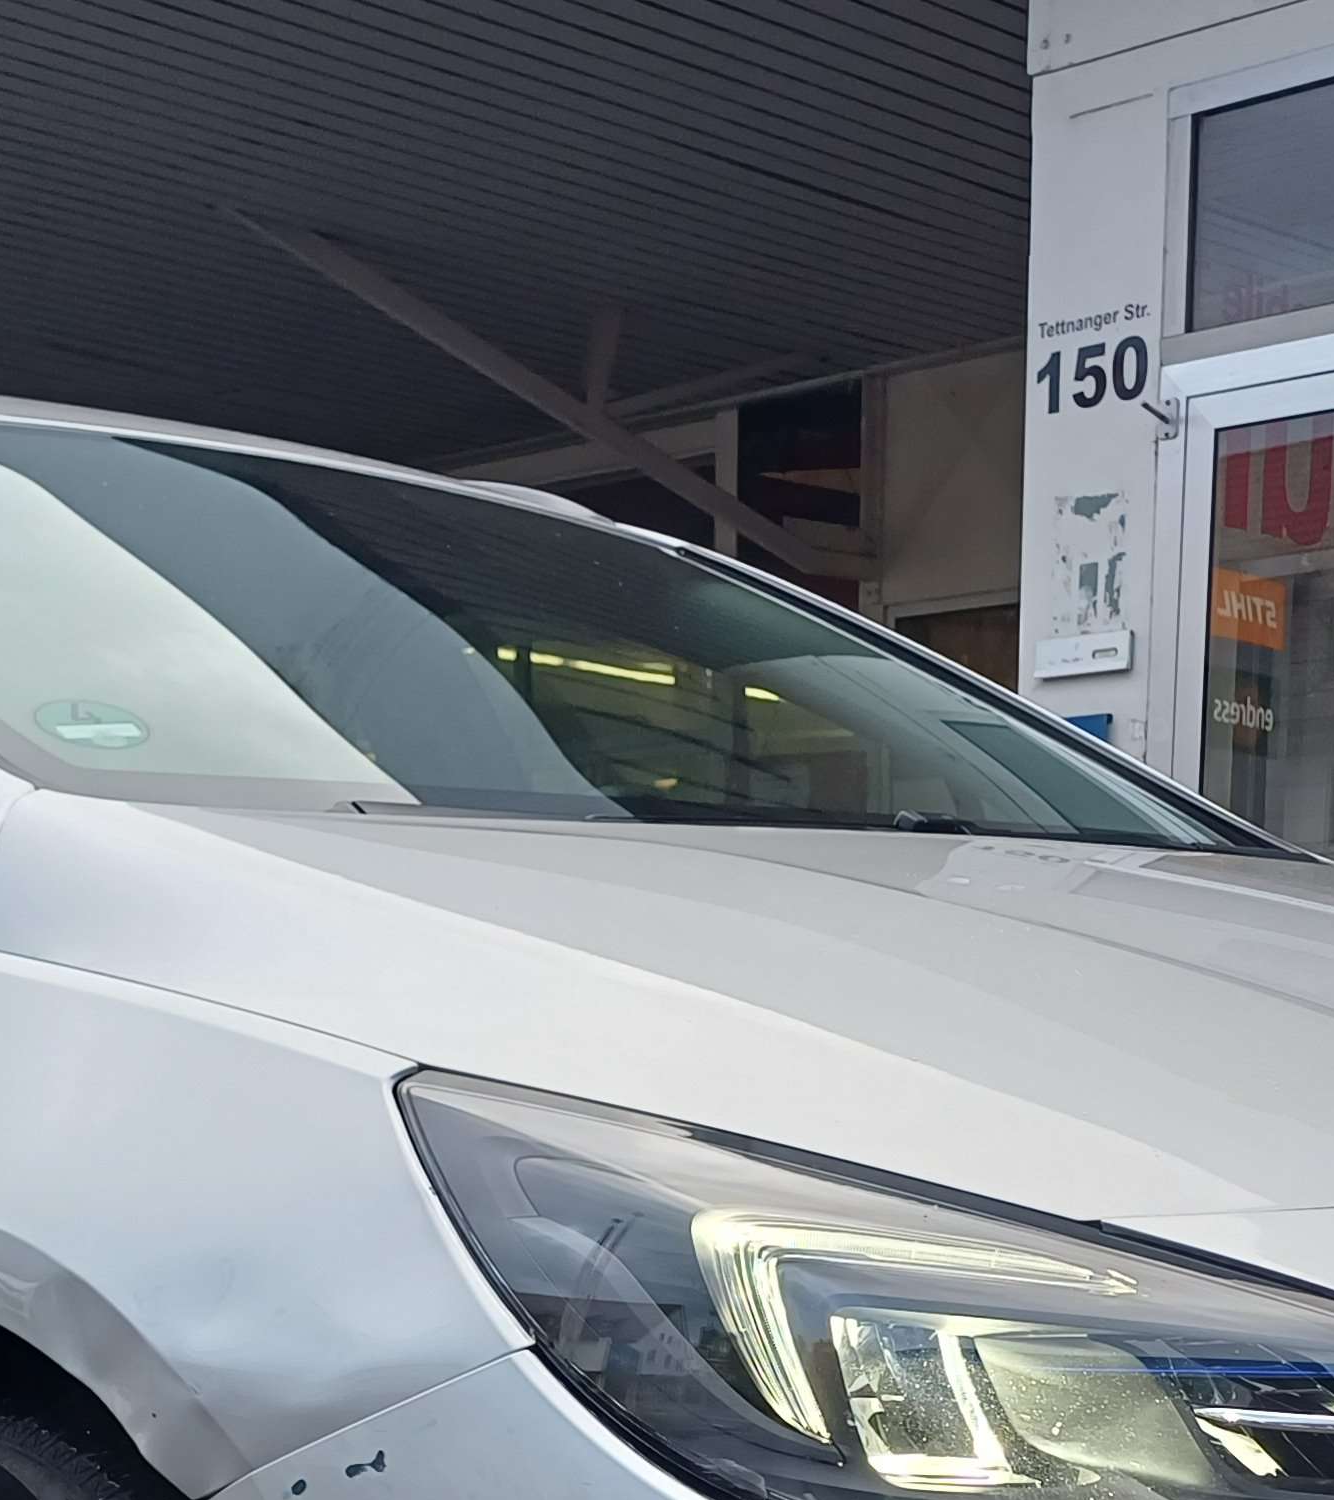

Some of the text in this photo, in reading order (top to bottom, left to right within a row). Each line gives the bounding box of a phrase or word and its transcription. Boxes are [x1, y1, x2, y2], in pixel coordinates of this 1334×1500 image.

[1038, 303, 1151, 339] Tettnanger Str.
[1037, 335, 1149, 415] 150
